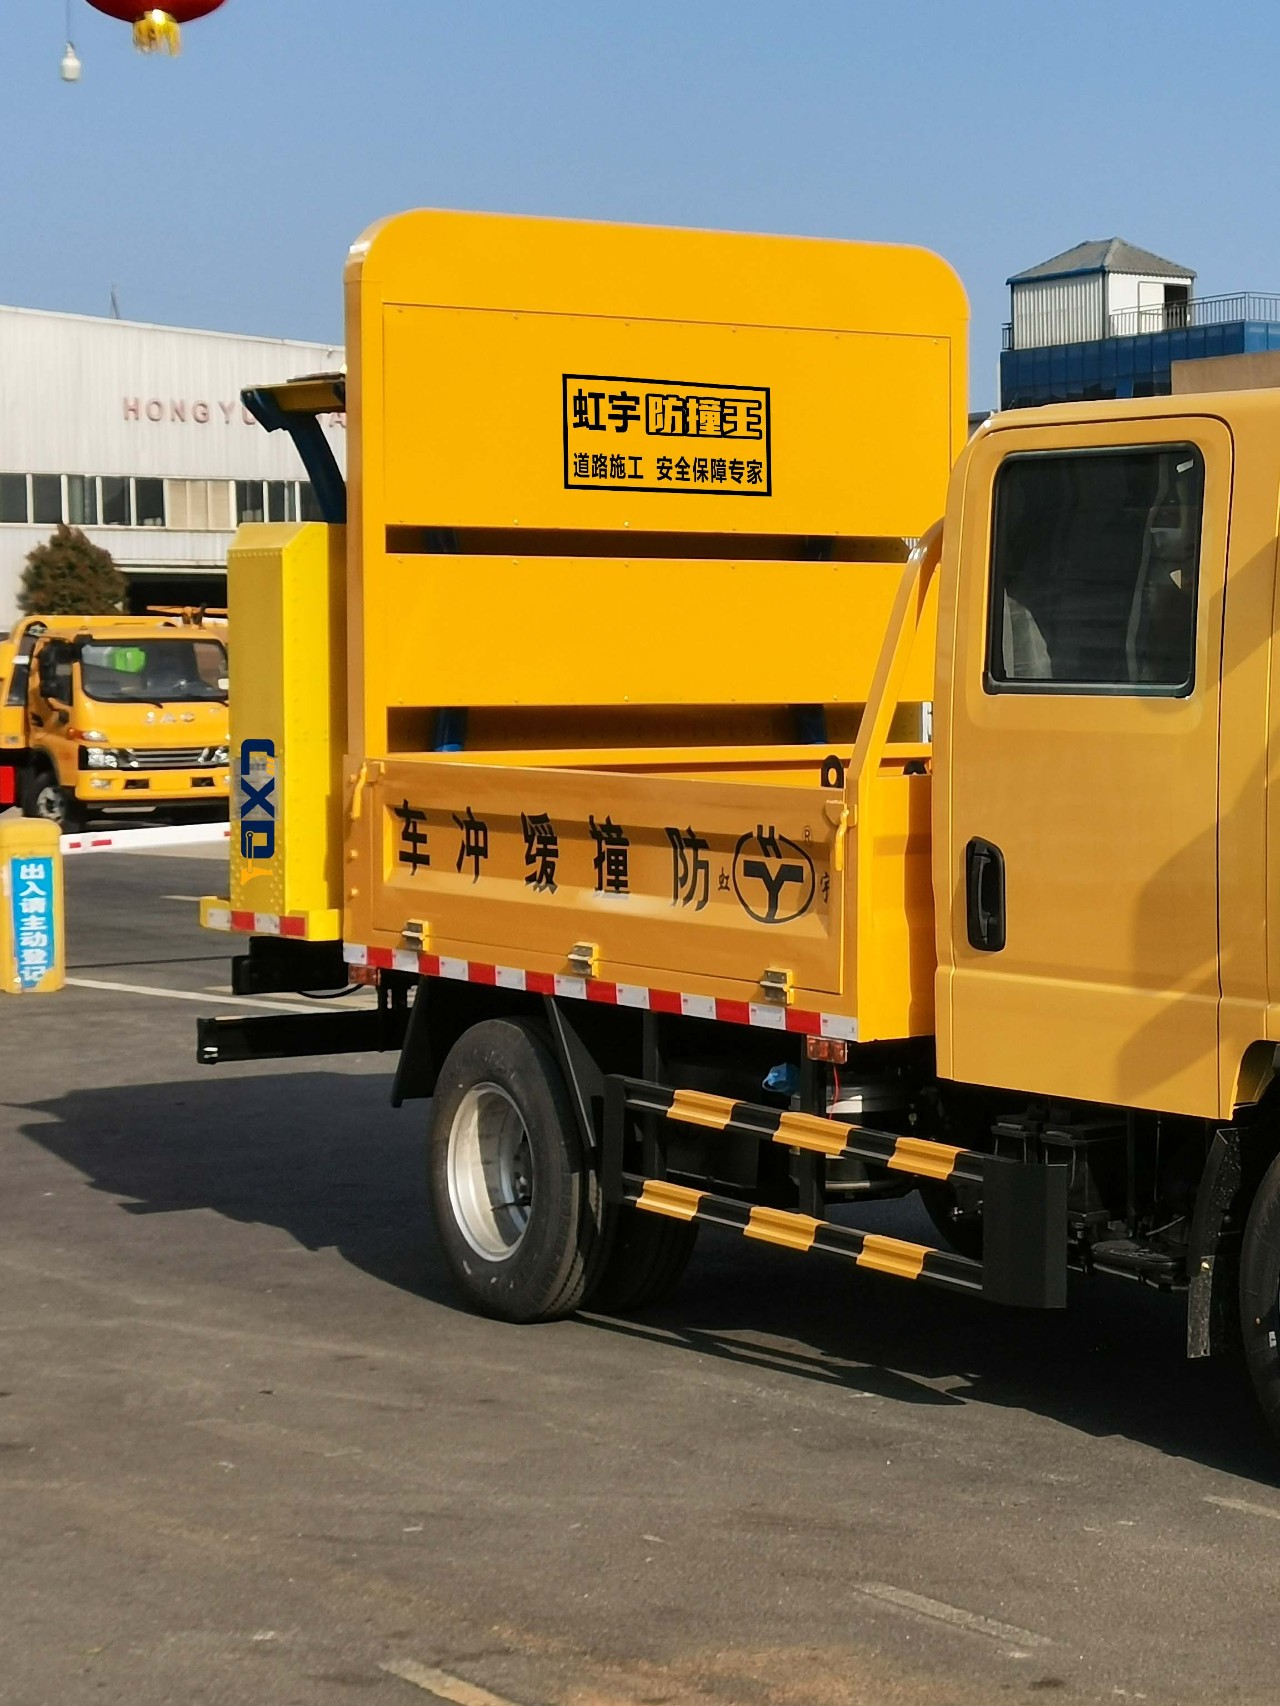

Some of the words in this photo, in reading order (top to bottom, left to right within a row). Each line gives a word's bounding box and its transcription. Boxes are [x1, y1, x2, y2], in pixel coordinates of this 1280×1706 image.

[572, 387, 641, 433] 虹宇
[645, 392, 763, 440] 防撞王
[573, 452, 645, 480] 道路施工
[656, 455, 764, 485] 安全保障专家
